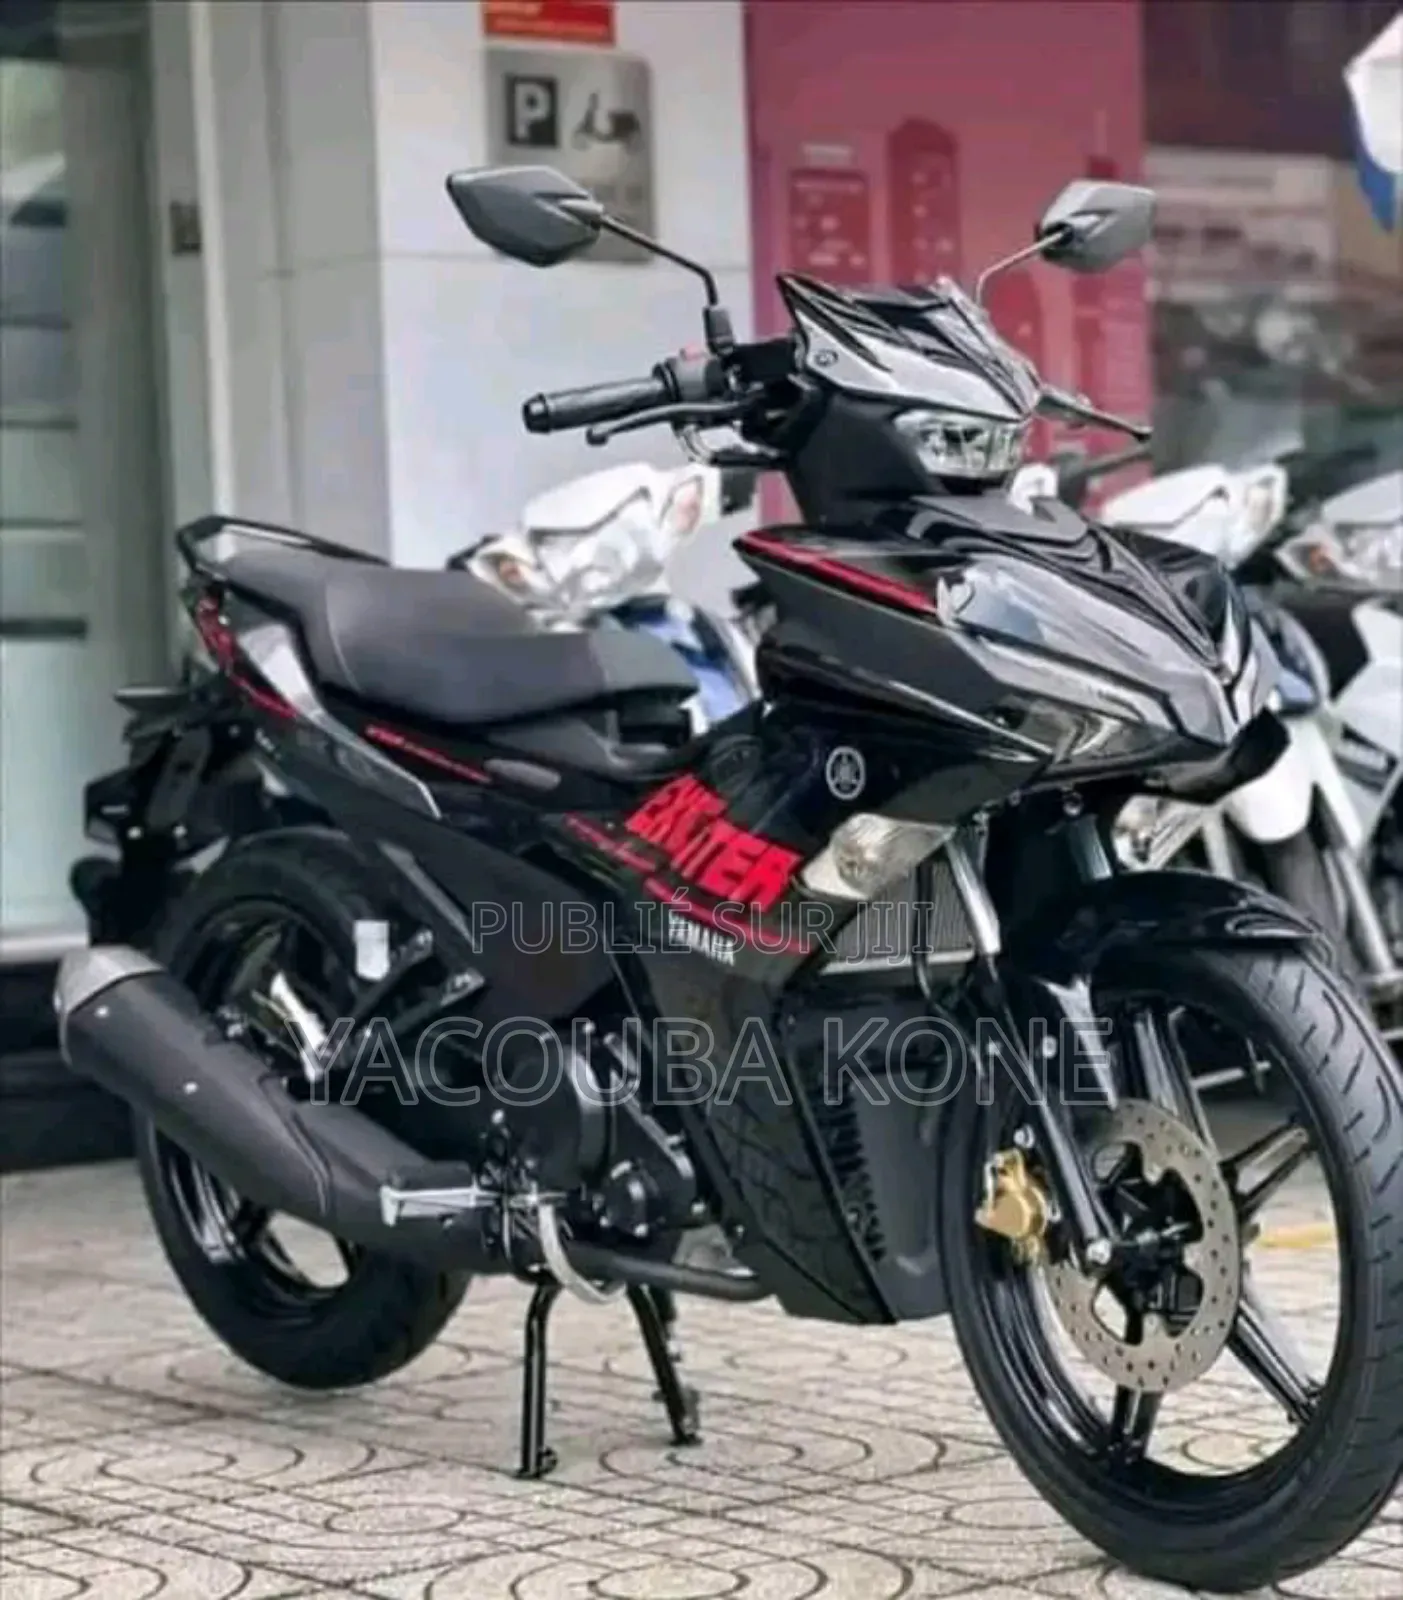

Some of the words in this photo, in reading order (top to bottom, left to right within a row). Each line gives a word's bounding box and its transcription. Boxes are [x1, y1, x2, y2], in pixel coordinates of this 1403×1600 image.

[514, 82, 549, 140] P
[625, 774, 803, 913] EXCITER
[668, 910, 735, 966] YAMAHA
